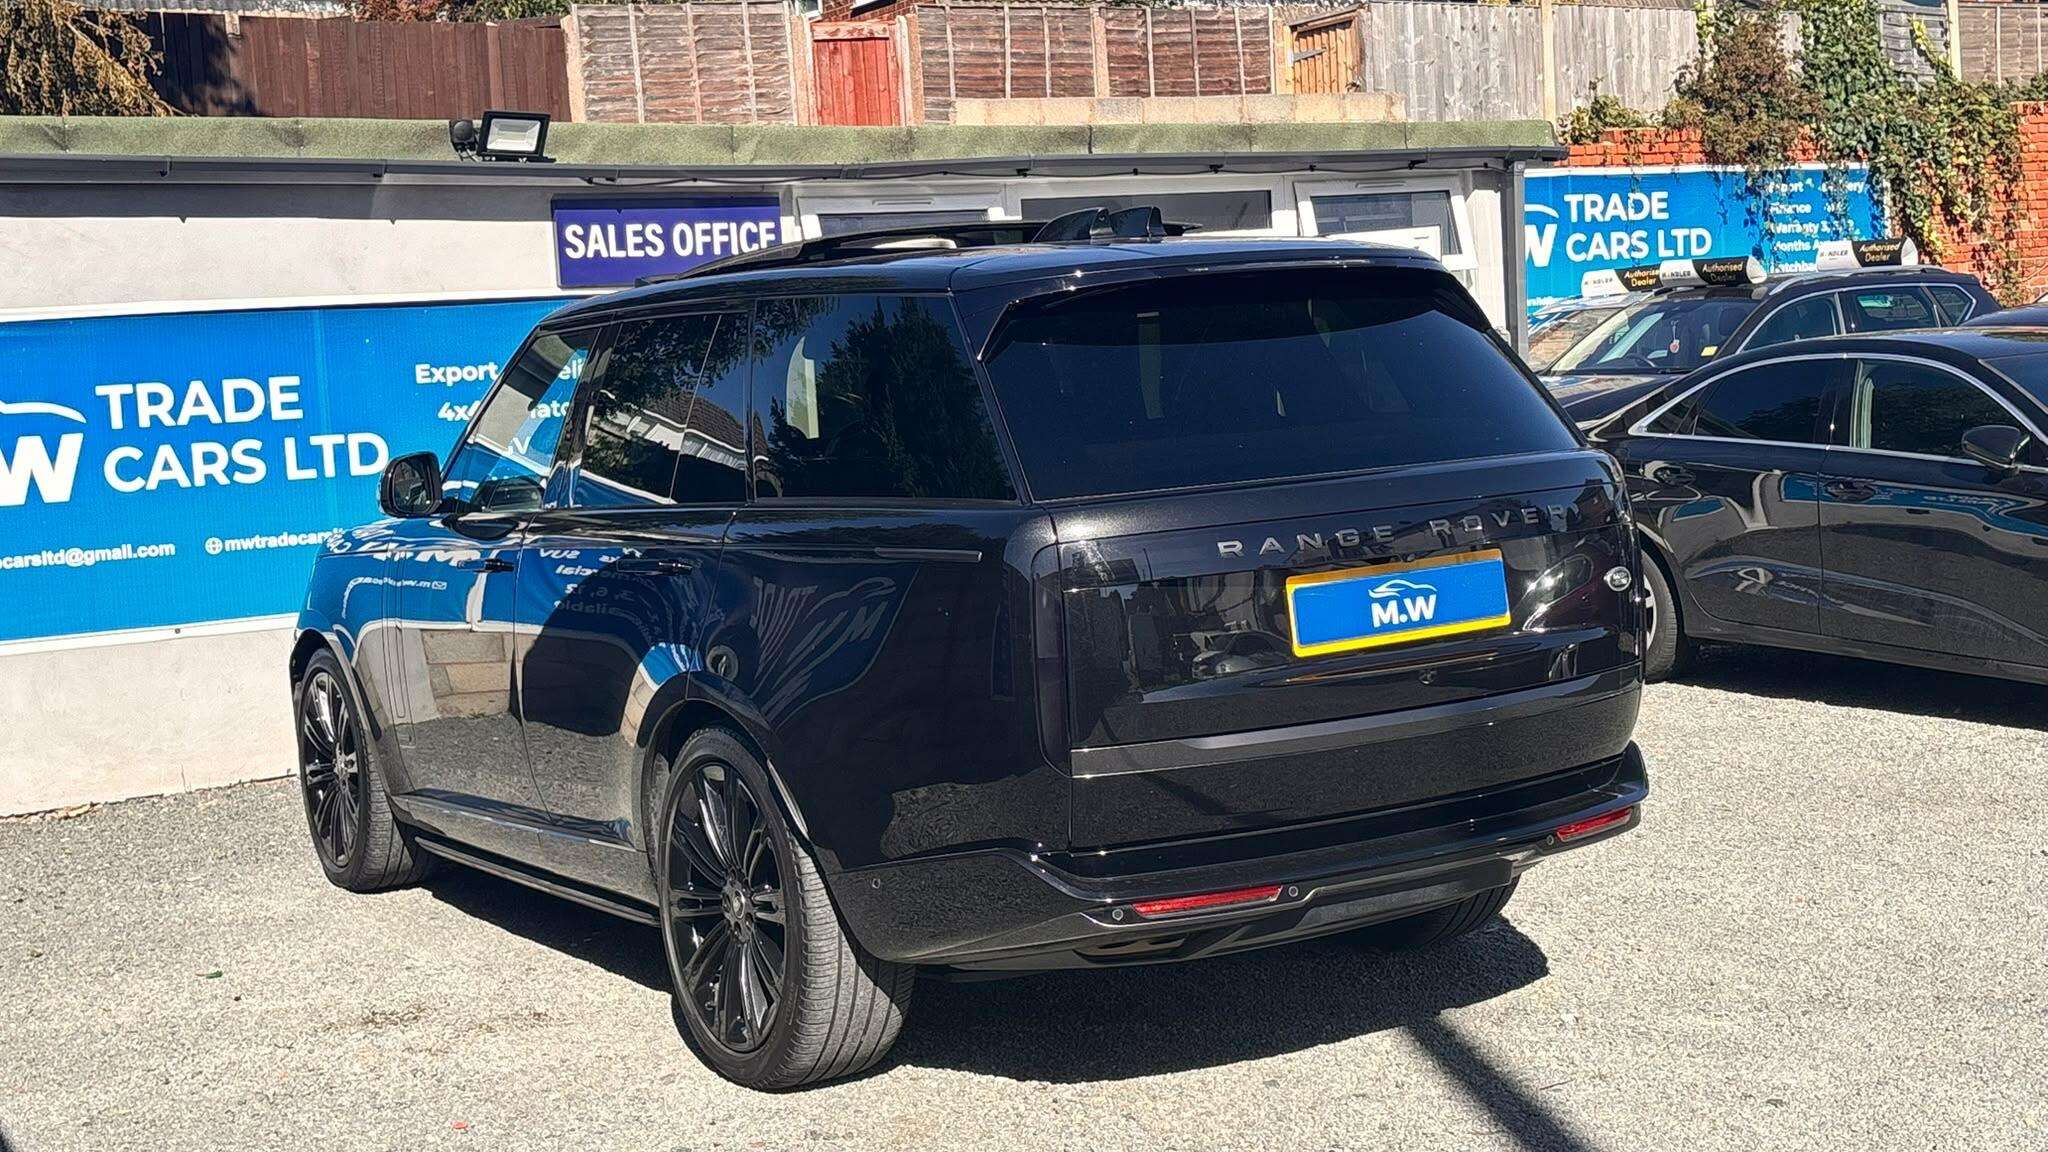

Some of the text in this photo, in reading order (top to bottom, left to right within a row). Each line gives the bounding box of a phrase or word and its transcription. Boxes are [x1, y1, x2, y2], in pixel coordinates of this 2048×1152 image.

[1563, 191, 1670, 223] TRADE
[565, 221, 776, 260] SALES OFFICE
[1565, 227, 1713, 262] CARS LTD
[1623, 268, 1660, 279] Authorise
[1864, 252, 1891, 263] Dealer
[1631, 277, 1657, 287] Dealer
[414, 361, 500, 387] Export
[95, 375, 303, 430] TRADE
[103, 432, 391, 493] CARS LTD
[1217, 504, 1569, 558] RANGE ROVER
